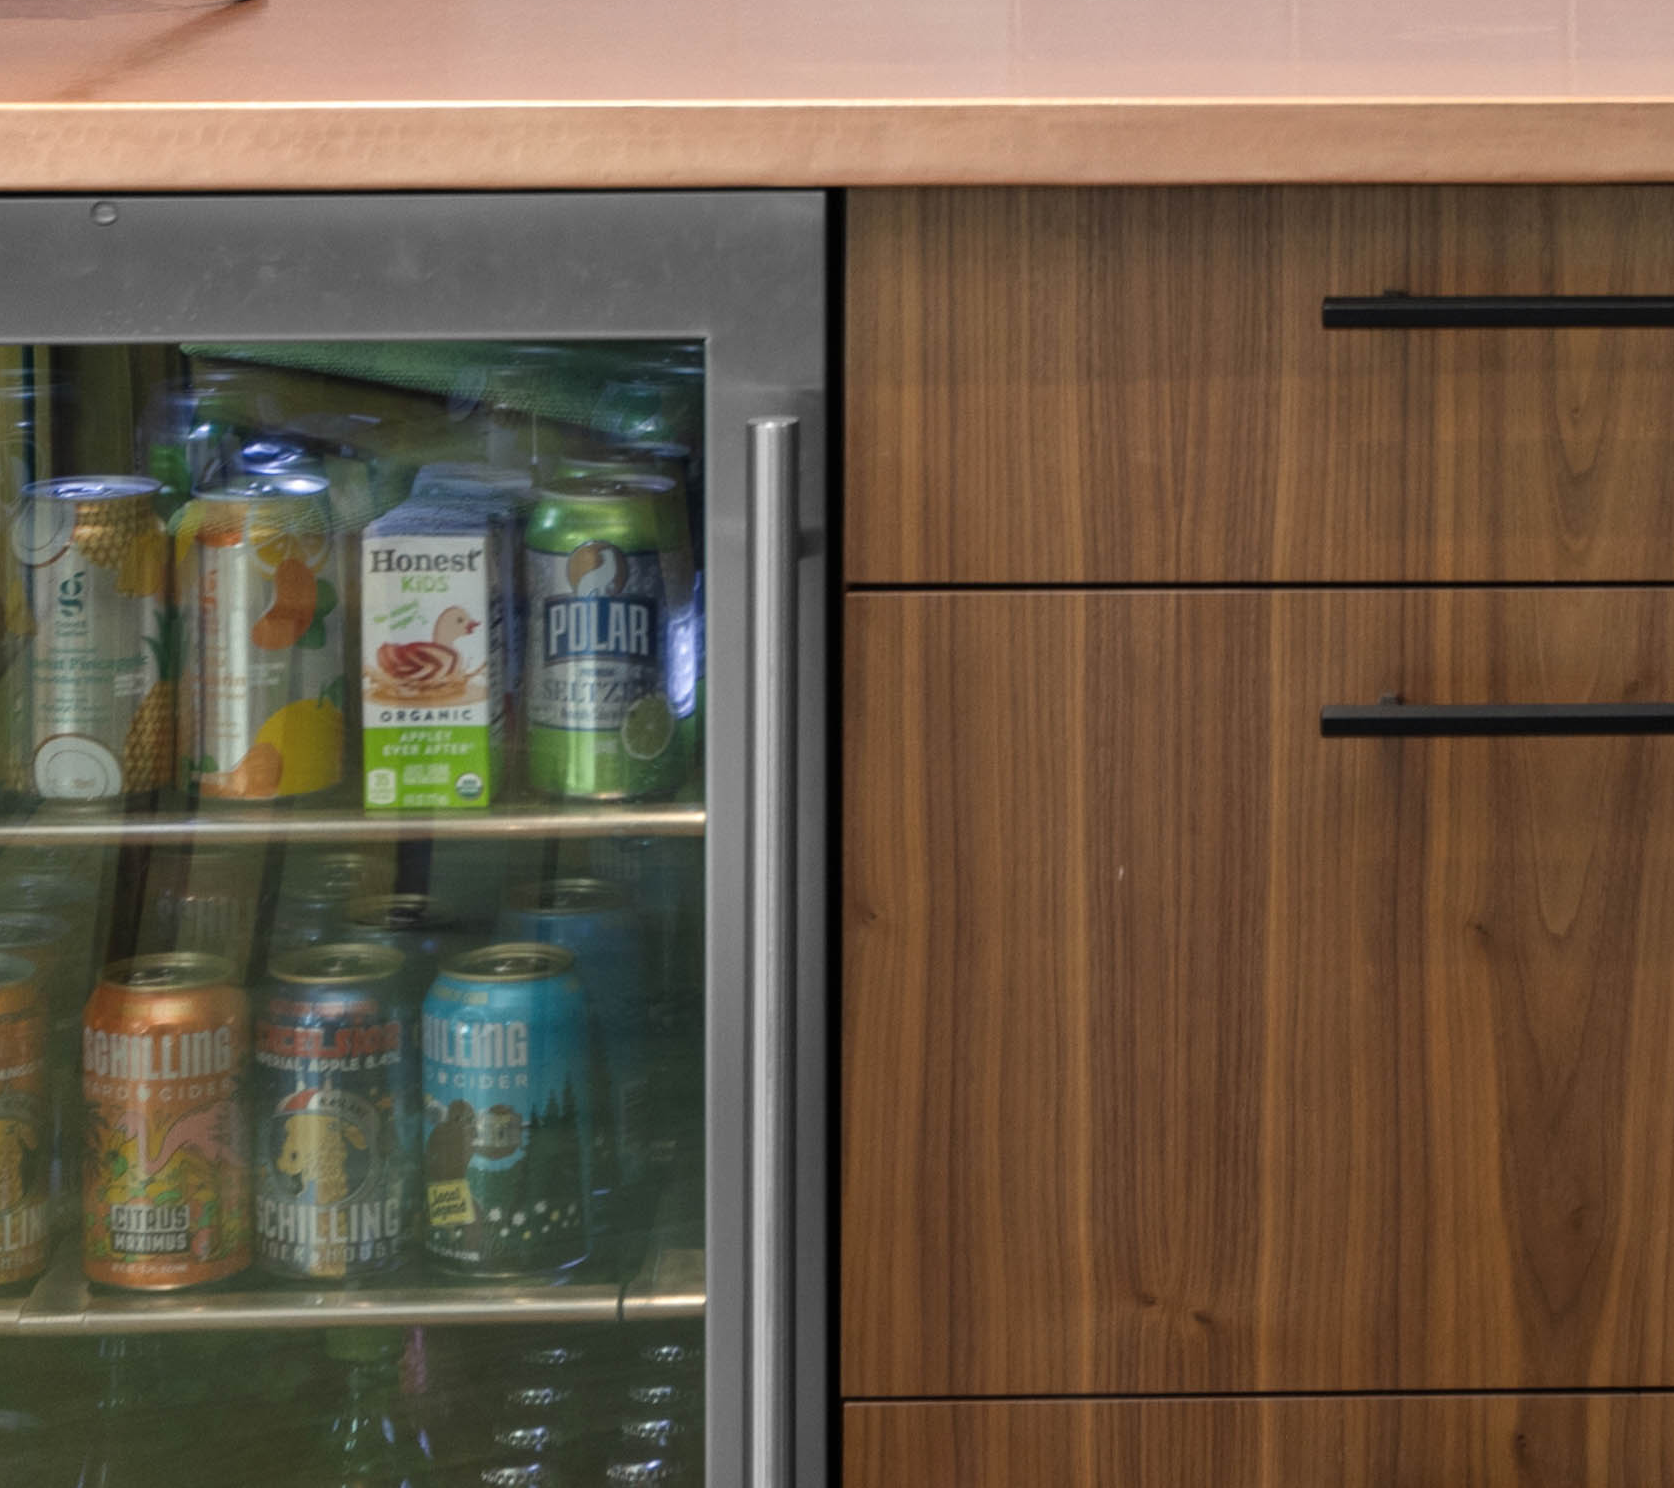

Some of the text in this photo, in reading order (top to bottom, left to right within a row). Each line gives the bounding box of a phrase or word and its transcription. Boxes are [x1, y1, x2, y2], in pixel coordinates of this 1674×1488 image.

[369, 547, 483, 574] Honest
[548, 601, 650, 656] POLAR
[380, 709, 474, 722] ORGANIC
[83, 1026, 232, 1082] SCHILLING
[307, 1057, 361, 1073] APPLE
[453, 1072, 529, 1090] CIDER
[114, 1205, 188, 1230] CITRUS
